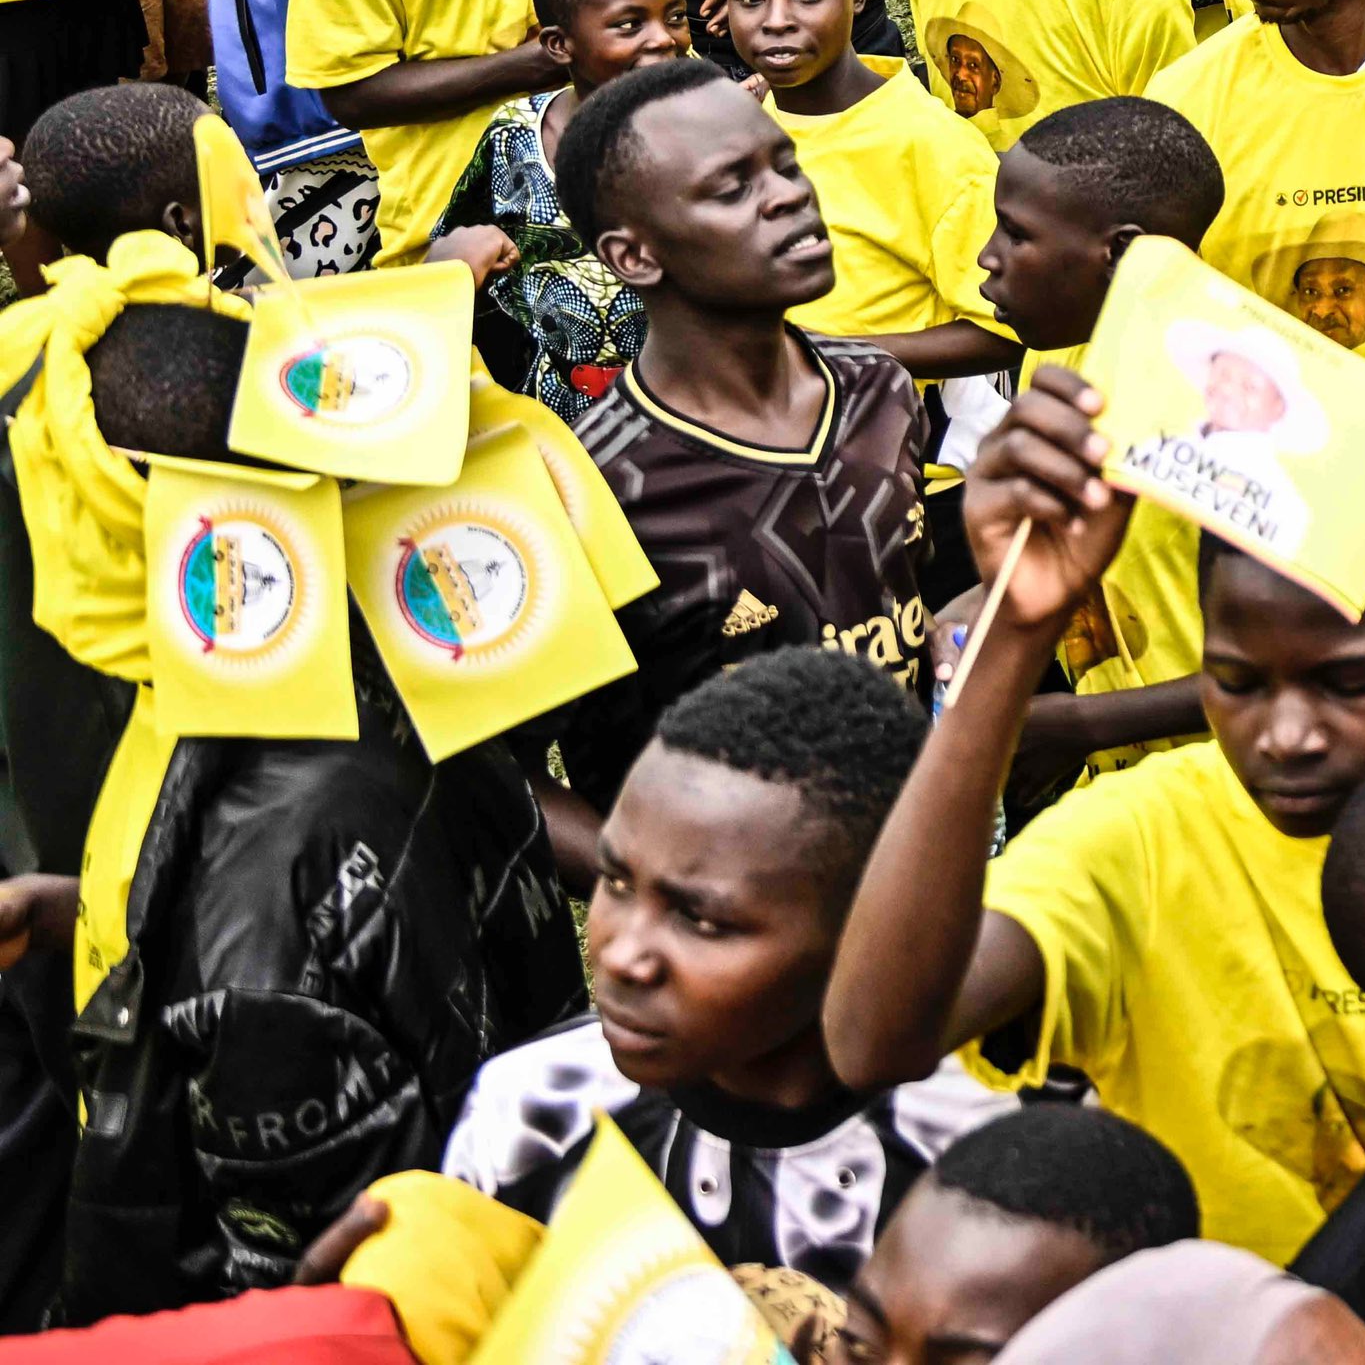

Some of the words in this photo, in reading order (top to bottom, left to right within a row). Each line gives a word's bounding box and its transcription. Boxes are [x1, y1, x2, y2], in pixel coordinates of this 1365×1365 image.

[1124, 444, 1279, 542] MUSEVENI
[1158, 429, 1273, 510] YOWERI
[722, 604, 779, 637] adidas
[822, 595, 927, 666] irate
